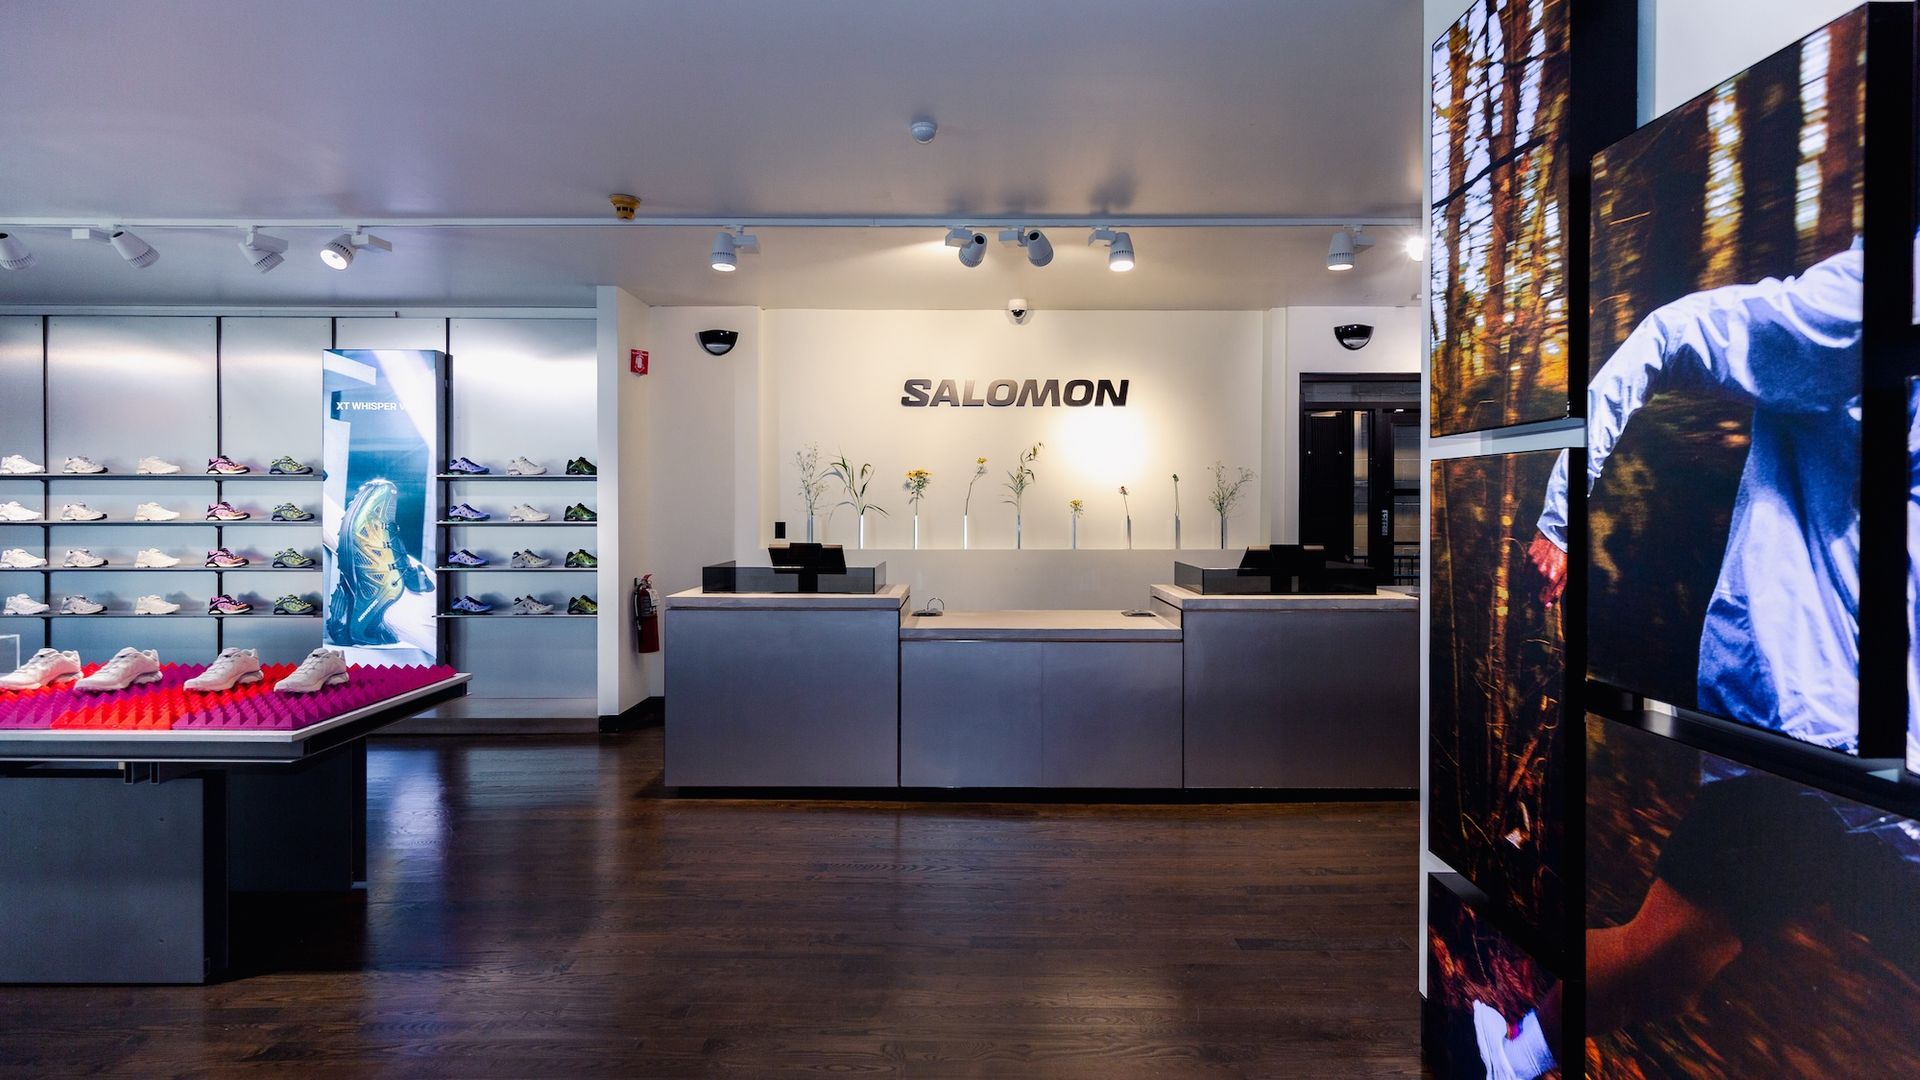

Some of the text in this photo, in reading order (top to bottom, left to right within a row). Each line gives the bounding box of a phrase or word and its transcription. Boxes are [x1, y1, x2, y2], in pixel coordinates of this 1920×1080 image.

[901, 379, 1130, 407] SALOMON
[336, 402, 350, 410] XT
[352, 402, 397, 410] WHISPER
